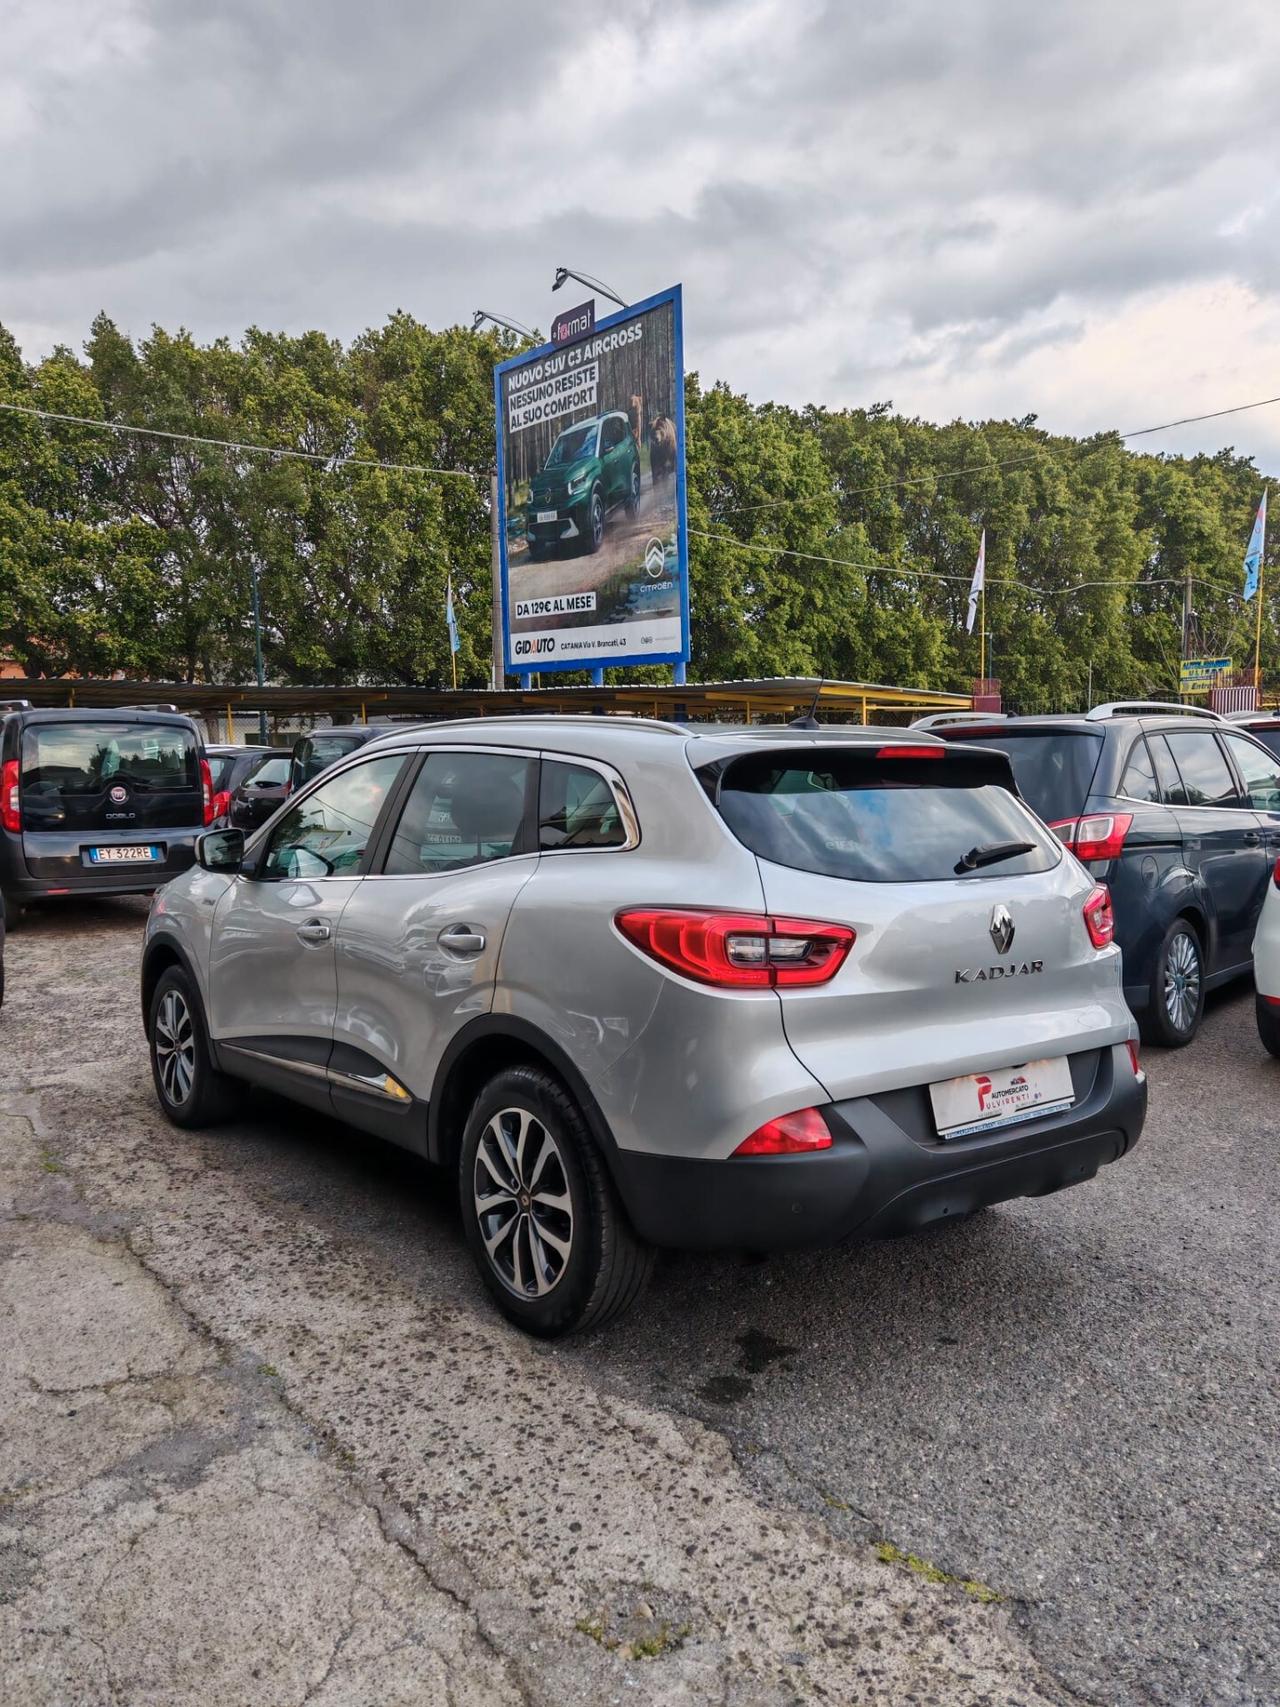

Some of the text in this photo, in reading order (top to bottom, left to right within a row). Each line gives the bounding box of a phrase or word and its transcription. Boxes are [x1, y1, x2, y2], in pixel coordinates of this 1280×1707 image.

[508, 322, 643, 391] NUOVO SUV C3 AIRCROSS
[510, 366, 596, 412] NESSUNO RESISTE
[511, 386, 594, 430] AL SUO COMFORT
[517, 604, 530, 616] DA
[531, 600, 551, 614] 129€
[553, 599, 565, 612] AL
[515, 637, 556, 655] GIDAUTO
[561, 641, 583, 651] CATANIA
[100, 848, 112, 860] EY
[954, 960, 1044, 984] KADJAR
[992, 1085, 1029, 1099] AUTOMERCATO
